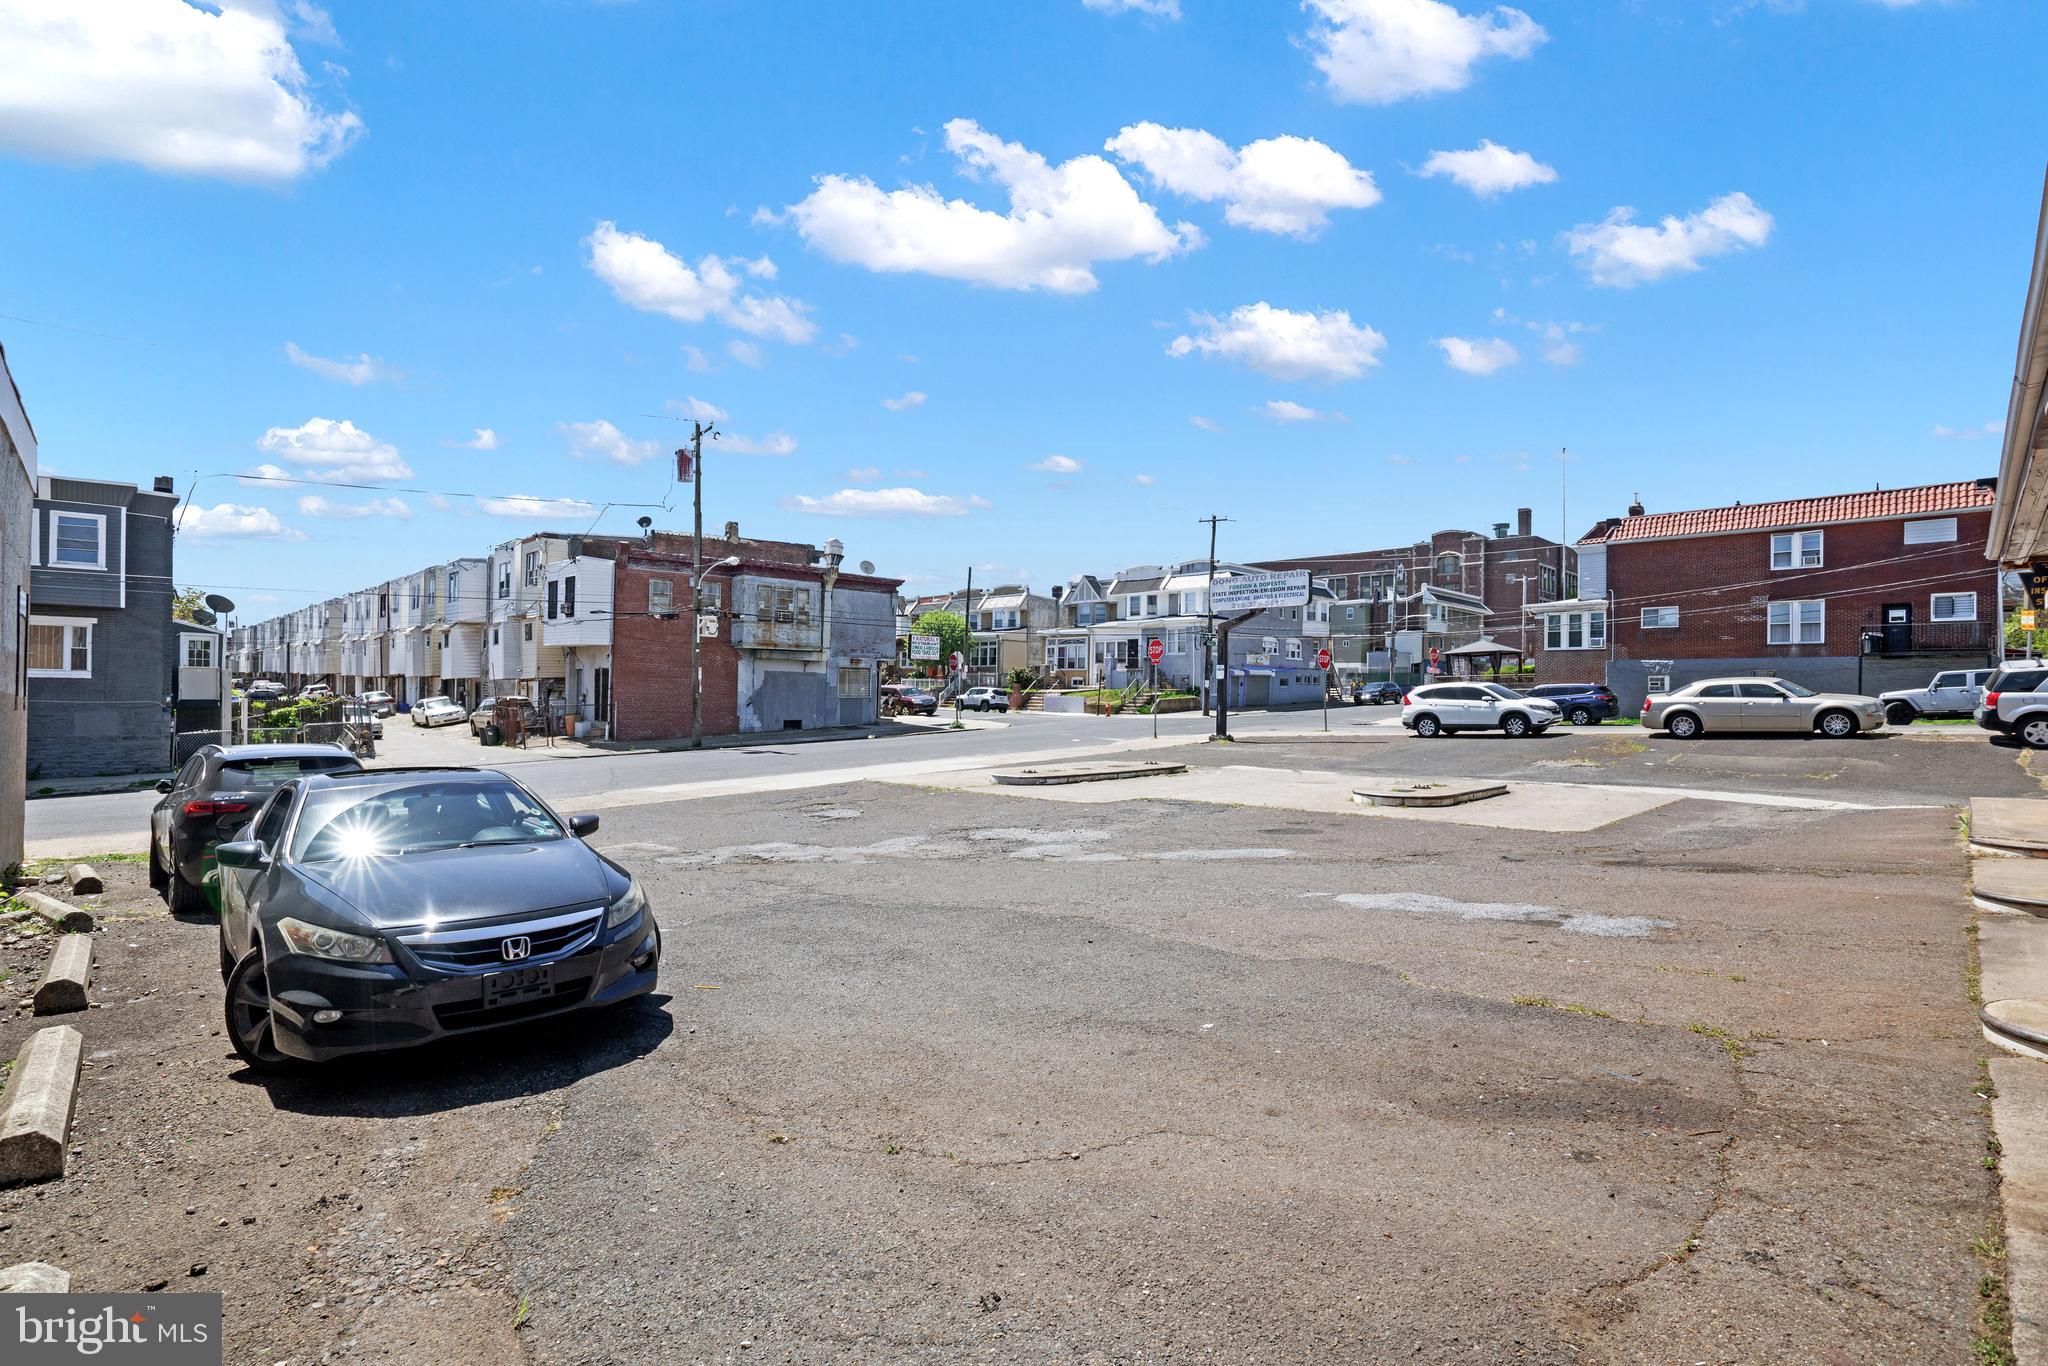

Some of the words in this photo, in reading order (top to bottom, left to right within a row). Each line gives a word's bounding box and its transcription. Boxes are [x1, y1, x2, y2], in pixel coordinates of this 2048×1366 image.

[1212, 576, 1239, 586] DONG
[1241, 574, 1267, 583] AUTO
[1270, 570, 1306, 580] REPAIR
[1228, 582, 1253, 590] FOREIGN
[1259, 580, 1287, 588] DOMESTIC
[1212, 596, 1235, 604] COMPUTER
[1253, 592, 1274, 600] ANALYSIS
[1279, 591, 1305, 599] ELECTRICAL
[1149, 645, 1163, 655] STOP
[1318, 655, 1330, 663] STOP
